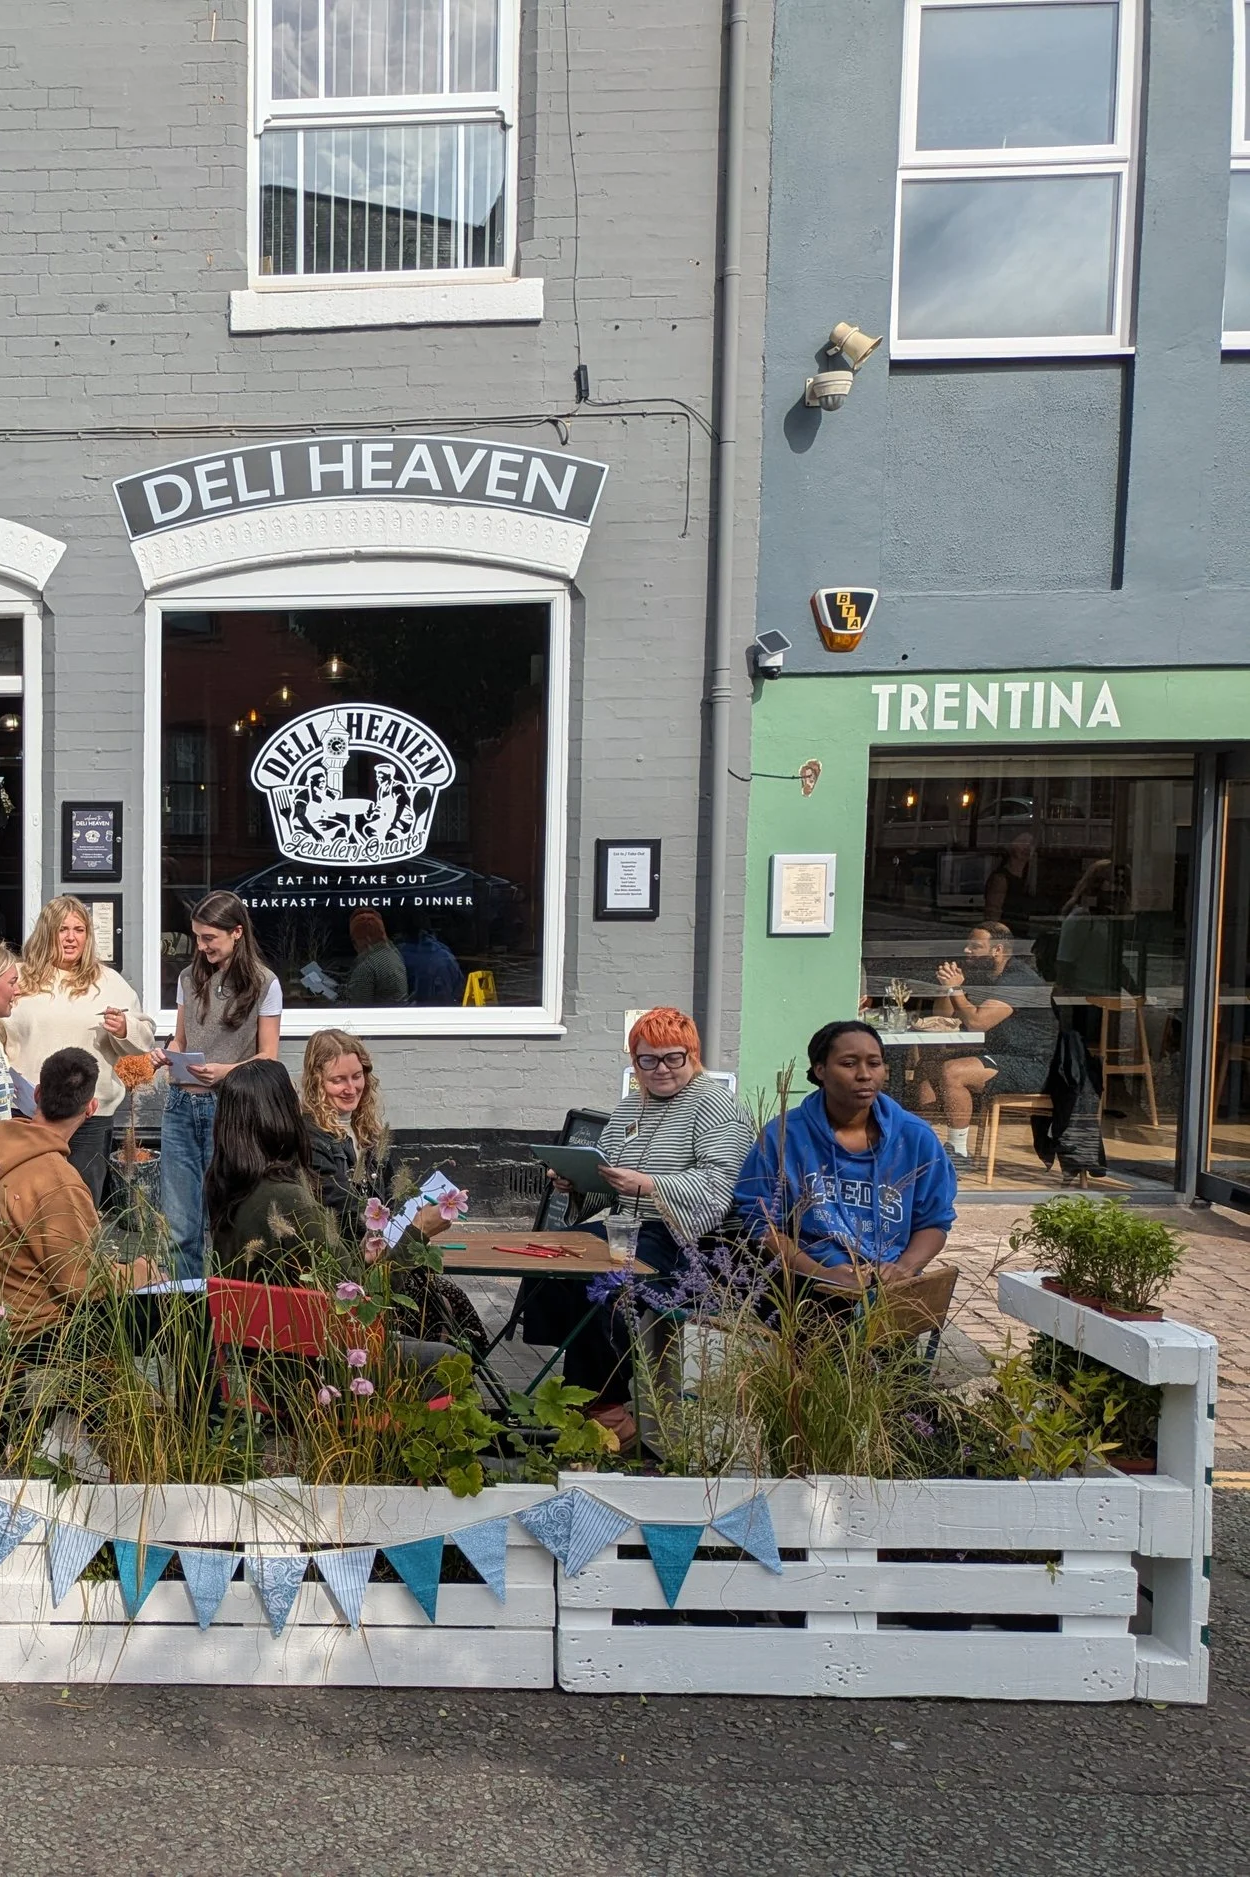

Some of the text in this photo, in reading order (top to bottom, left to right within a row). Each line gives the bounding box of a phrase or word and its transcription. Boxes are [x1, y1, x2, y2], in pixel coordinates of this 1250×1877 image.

[142, 443, 577, 525] DELI HEAVEN
[871, 680, 1121, 731] TRENTINA
[262, 712, 445, 781] DELI HEAVEN
[283, 830, 426, 863] Jewellery Quarter
[277, 876, 303, 885] EAT
[312, 875, 328, 885] IN
[350, 875, 387, 885] TAKE
[396, 875, 428, 884] OUT
[241, 897, 317, 908] REAKFAST
[339, 897, 391, 907] LUNCH
[414, 896, 473, 906] DINNER
[568, 1136, 597, 1148] BREAKFAST
[805, 1172, 903, 1223] LEEDS
[861, 1220, 890, 1233] 194
